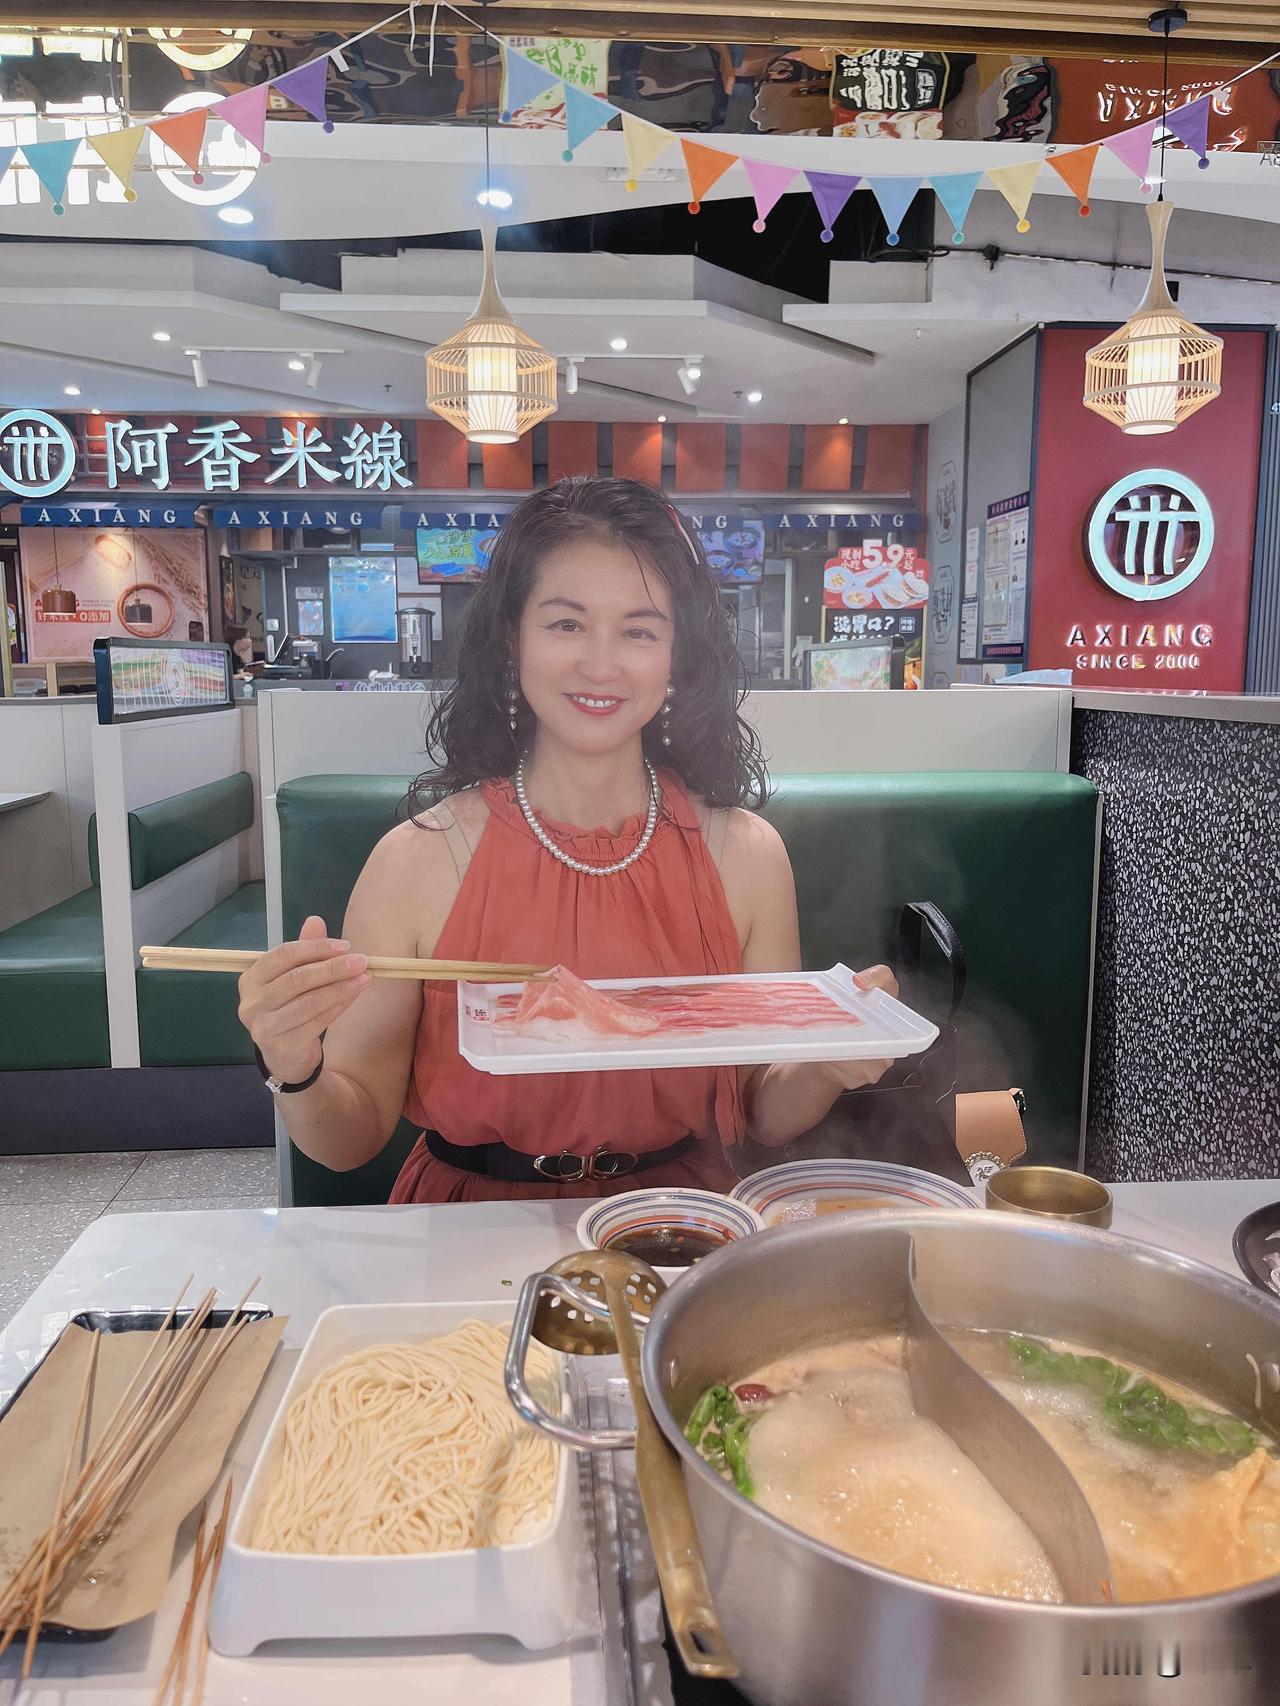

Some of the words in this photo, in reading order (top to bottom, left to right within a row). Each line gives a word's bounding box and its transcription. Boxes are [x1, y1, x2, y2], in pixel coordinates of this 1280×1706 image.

[105, 419, 413, 492] 阿香米線
[38, 508, 177, 524] AXIANG
[228, 510, 363, 526] AXIANG
[417, 512, 500, 527] AXIA
[778, 514, 905, 529] AXIANG
[862, 539, 904, 569] 5.9
[1065, 623, 1214, 647] AXIANG
[1076, 654, 1147, 669] SINCE
[1154, 654, 1200, 669] 2000
